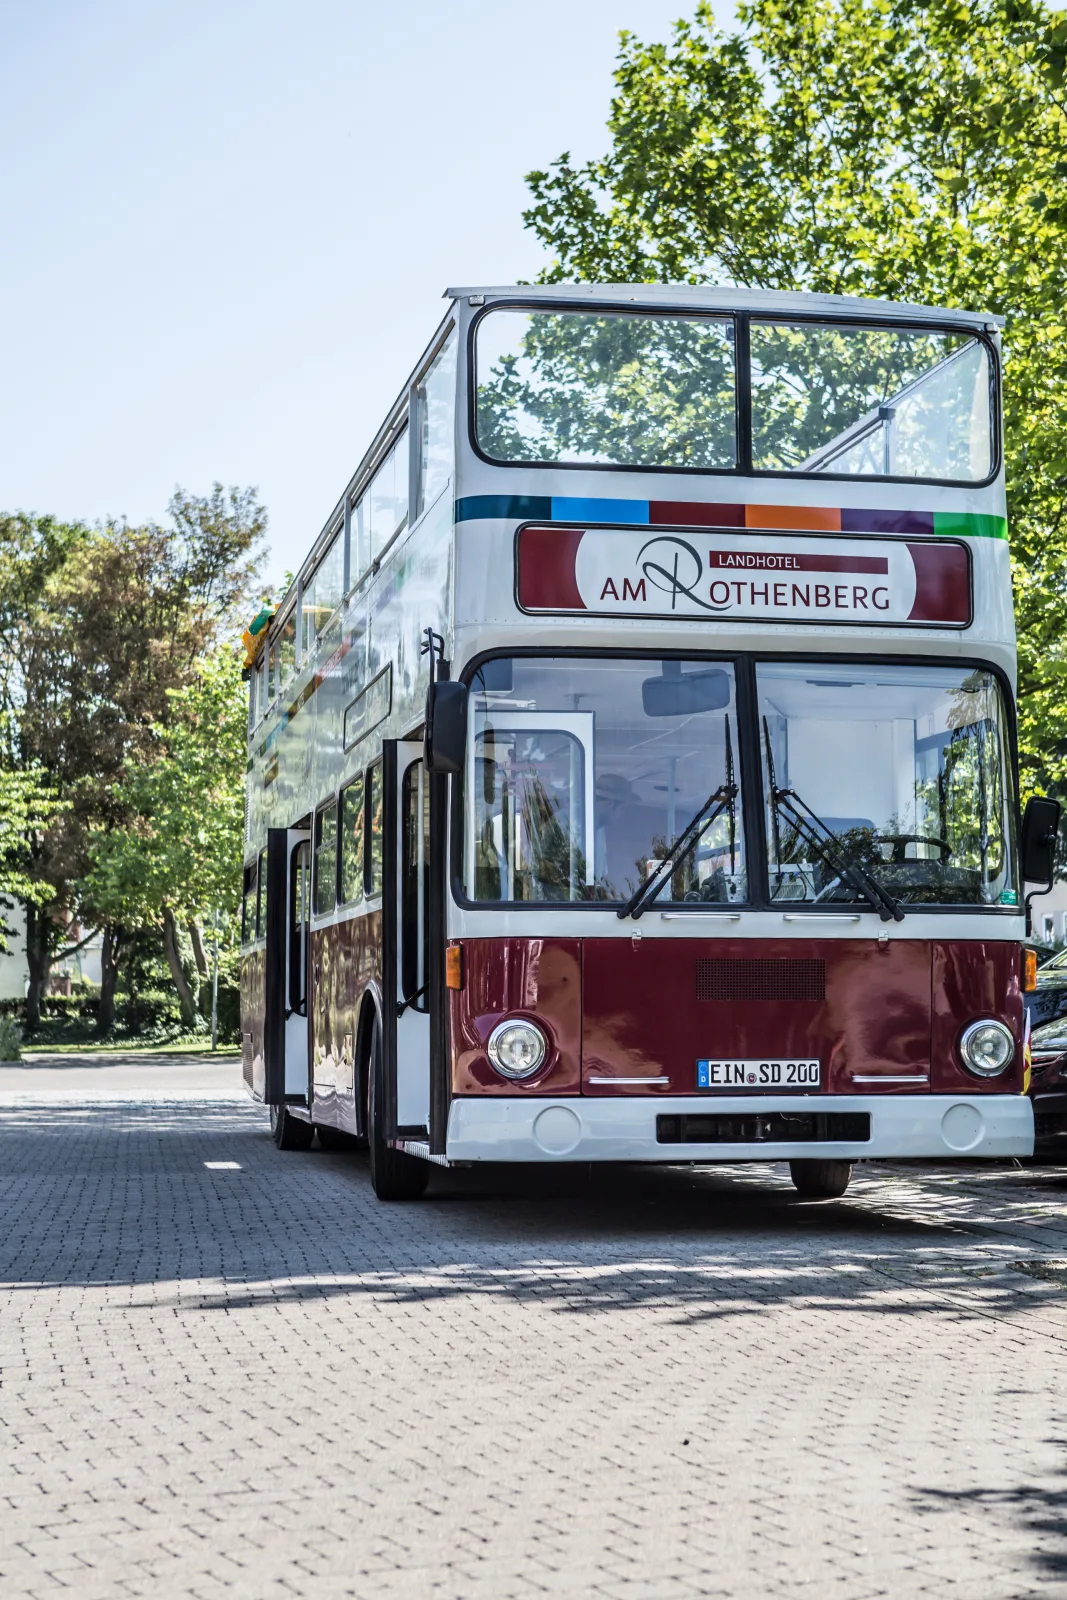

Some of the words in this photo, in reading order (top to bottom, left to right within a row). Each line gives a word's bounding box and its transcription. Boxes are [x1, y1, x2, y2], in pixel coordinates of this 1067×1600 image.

[718, 554, 800, 569] LANDHOTEL
[600, 577, 647, 602] AM
[710, 1064, 745, 1084] EIN
[759, 1063, 781, 1083] SD
[786, 1063, 819, 1083] 200
